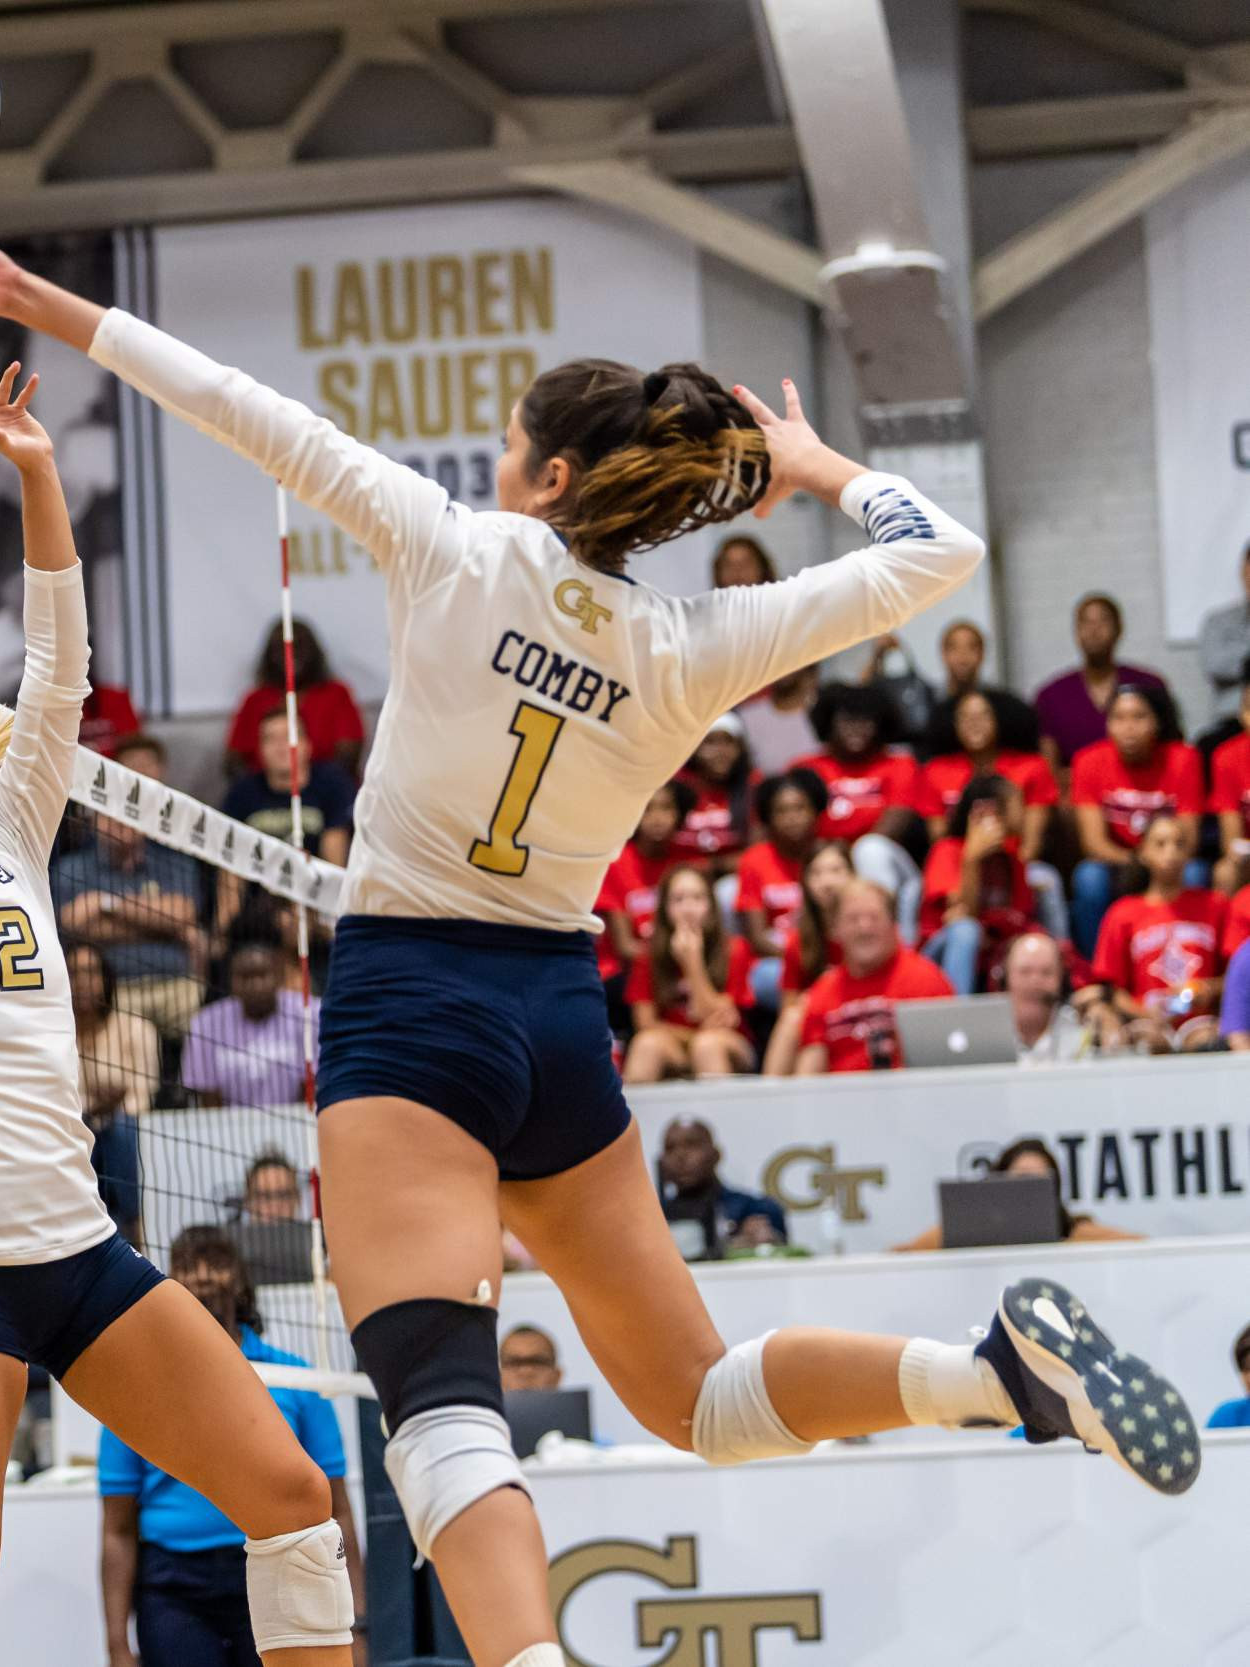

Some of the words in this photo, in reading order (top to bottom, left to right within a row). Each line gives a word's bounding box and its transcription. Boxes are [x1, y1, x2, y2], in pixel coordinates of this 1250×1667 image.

[295, 246, 555, 350] LAUREN
[553, 578, 613, 635] GT
[491, 629, 630, 723] COMBY
[467, 698, 566, 878] 1
[1058, 1127, 1250, 1200] TATHL
